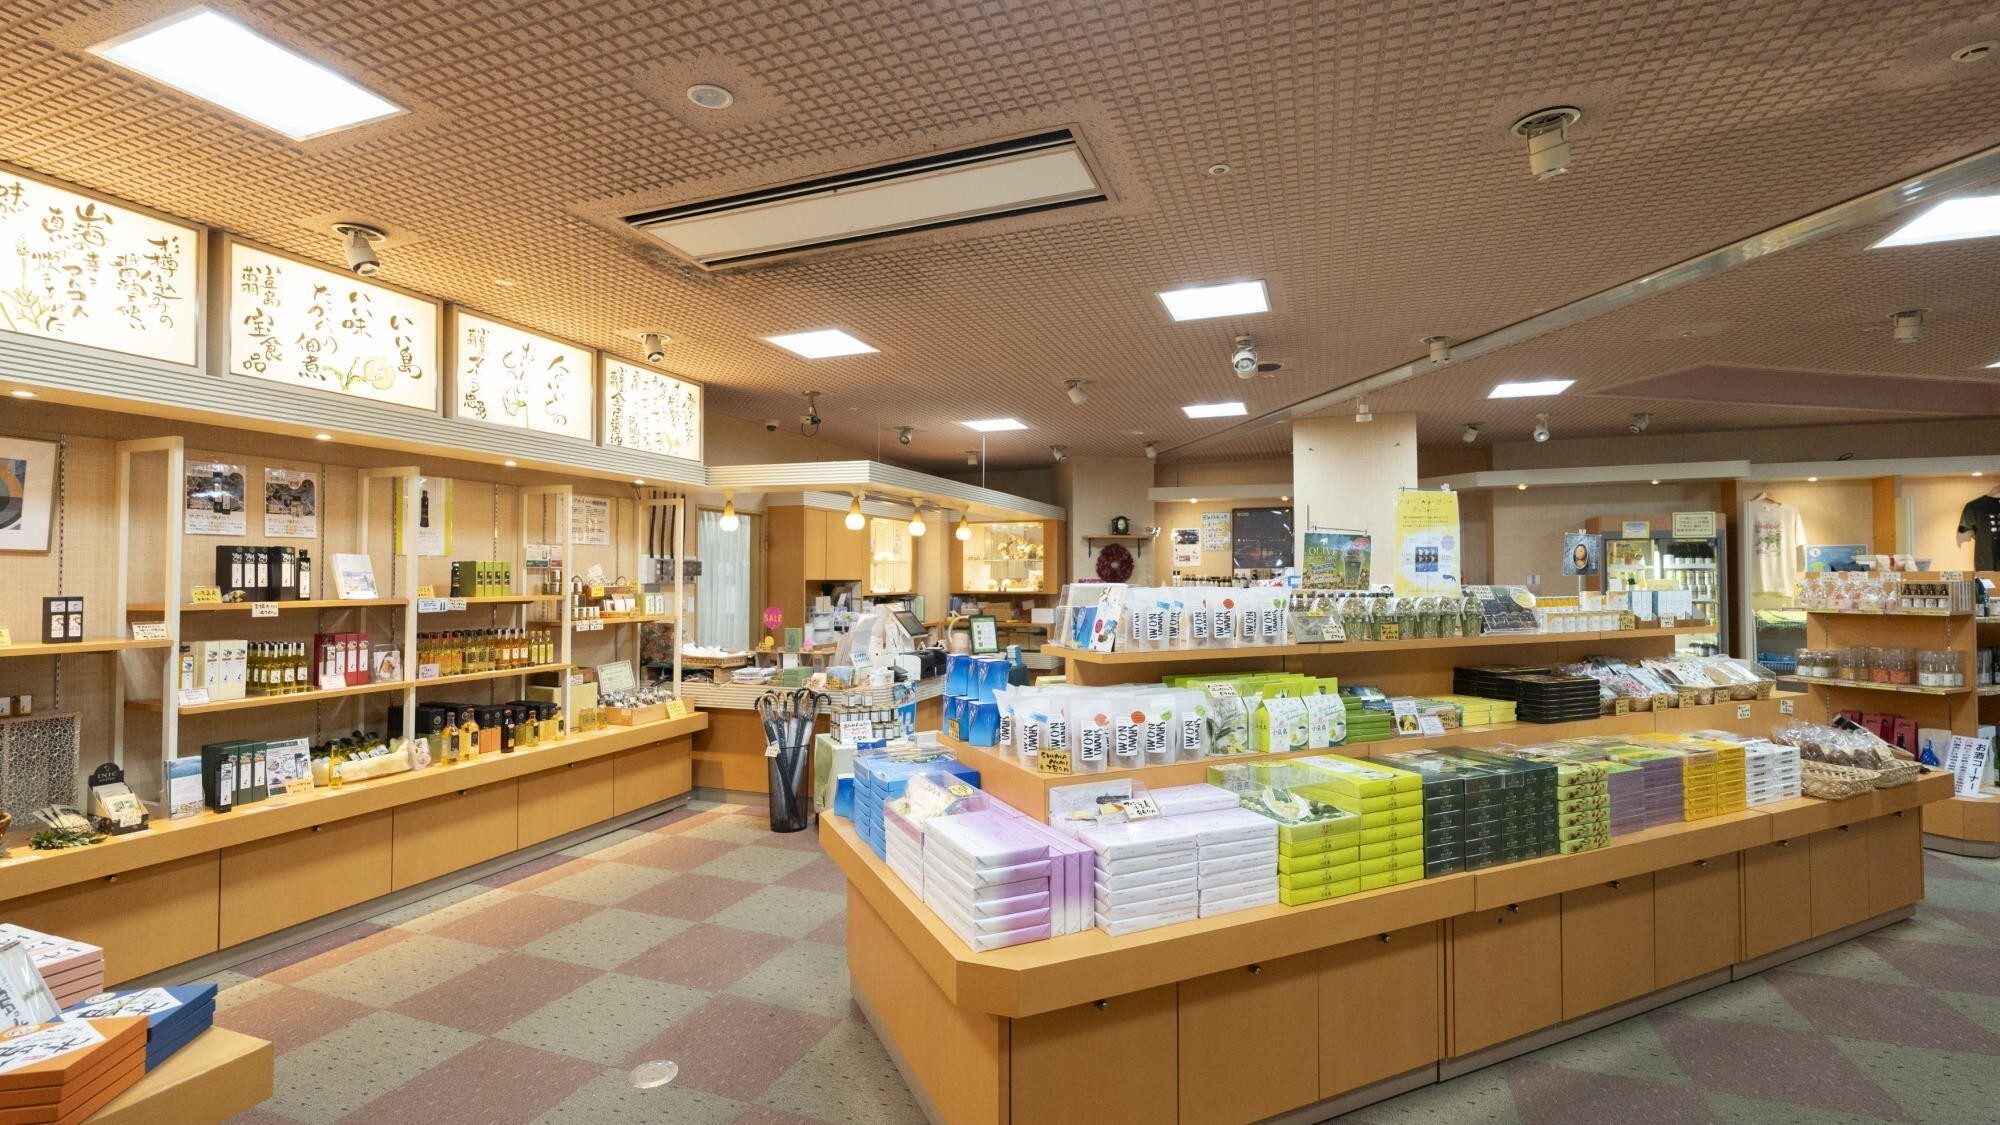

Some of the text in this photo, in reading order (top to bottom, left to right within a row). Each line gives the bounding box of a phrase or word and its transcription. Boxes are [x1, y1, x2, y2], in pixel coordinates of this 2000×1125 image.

[341, 291, 373, 339] いい味
[764, 613, 783, 622] SALE
[1083, 729, 1093, 759] NOMI
[1117, 725, 1127, 754] NOMI
[1147, 723, 1156, 751] NOMI
[1184, 720, 1195, 747] NOMI
[1968, 743, 1987, 791] お酒コーナー
